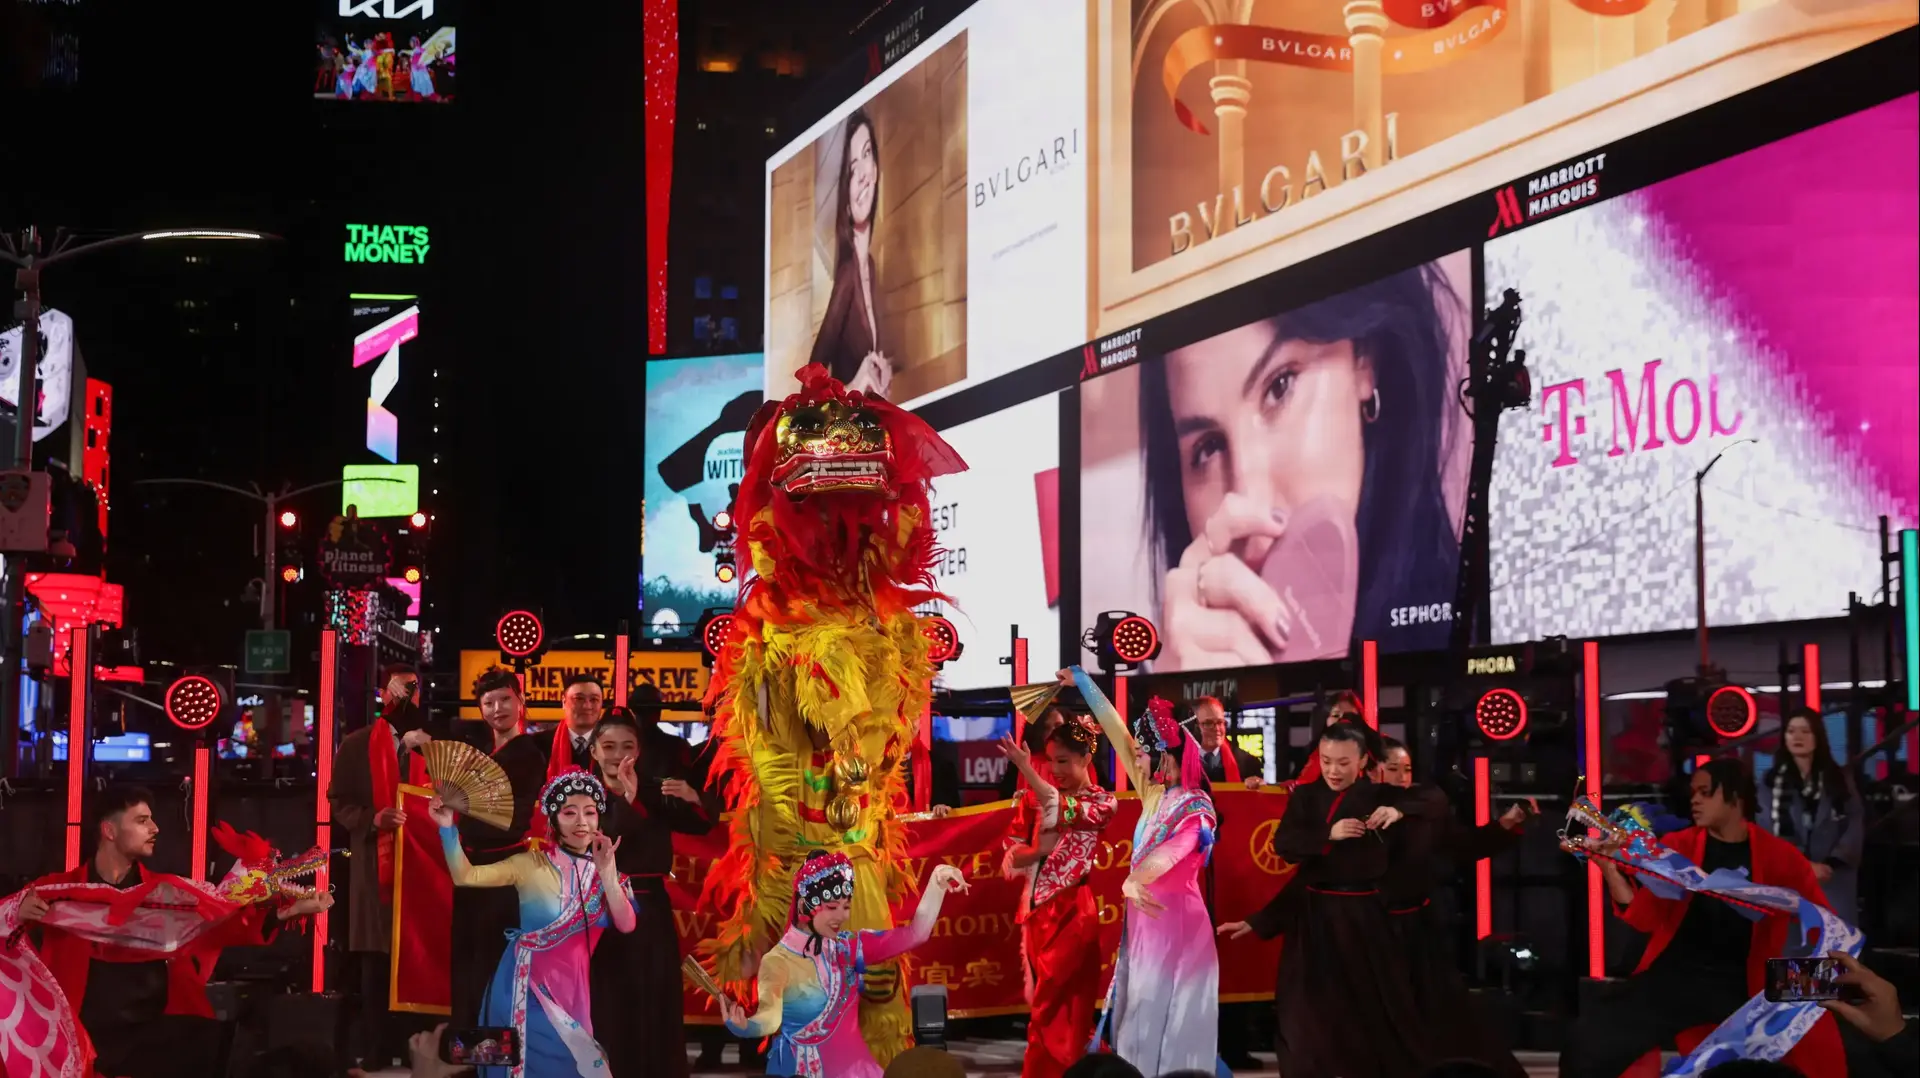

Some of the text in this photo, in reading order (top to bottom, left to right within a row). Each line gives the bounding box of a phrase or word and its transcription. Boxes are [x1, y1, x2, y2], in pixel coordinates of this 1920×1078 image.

[975, 128, 1077, 208] BVLGARI
[1528, 153, 1606, 196] MARRIOTT
[1169, 112, 1398, 255] BVLGARI
[1528, 179, 1597, 216] MARQUIS
[346, 224, 429, 245] THAT'S
[345, 243, 430, 264] MONEY
[1100, 328, 1142, 353] MARRIOTT
[1101, 345, 1137, 369] MARQUIS
[324, 548, 375, 563] planet
[331, 560, 384, 574] fitness
[931, 547, 967, 577] VER
[1391, 602, 1461, 627] SEPHOR
[1467, 655, 1517, 675] PHORA
[659, 667, 698, 689] EVE
